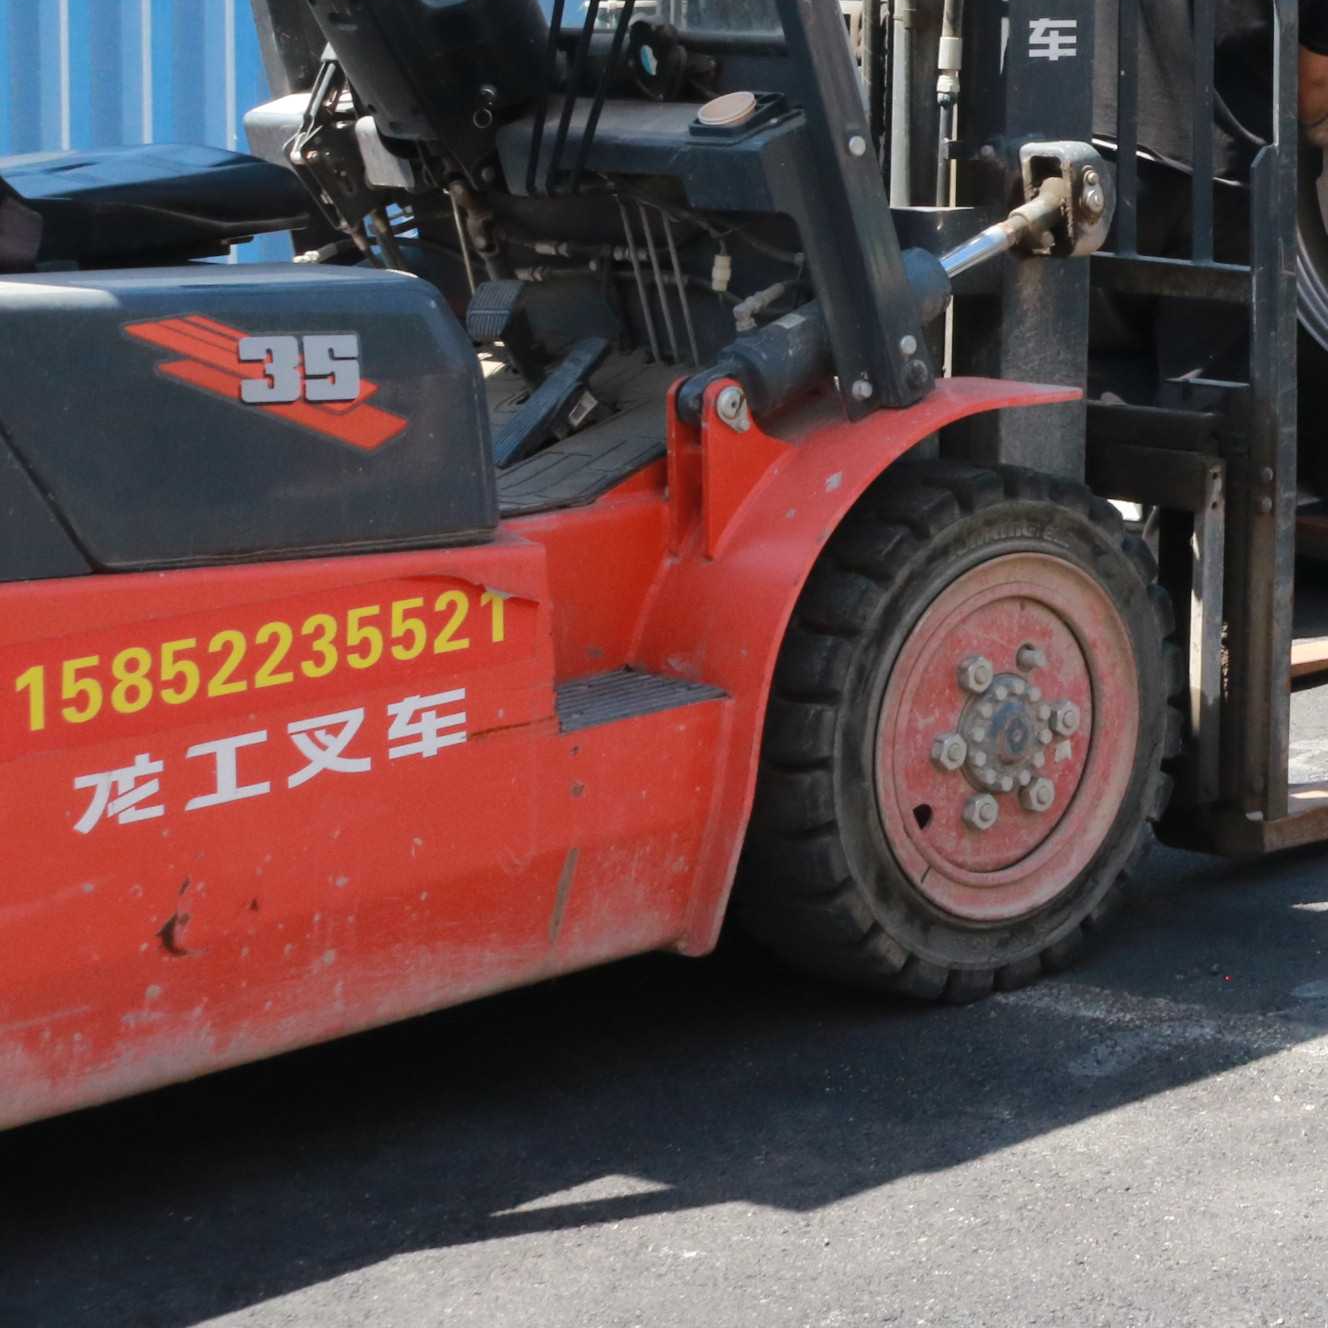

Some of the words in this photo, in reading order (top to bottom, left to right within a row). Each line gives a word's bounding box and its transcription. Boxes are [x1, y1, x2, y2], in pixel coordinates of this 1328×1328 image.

[238, 333, 360, 403] 35
[15, 590, 506, 732] 15852235521
[73, 688, 467, 834] 龙工叉车
